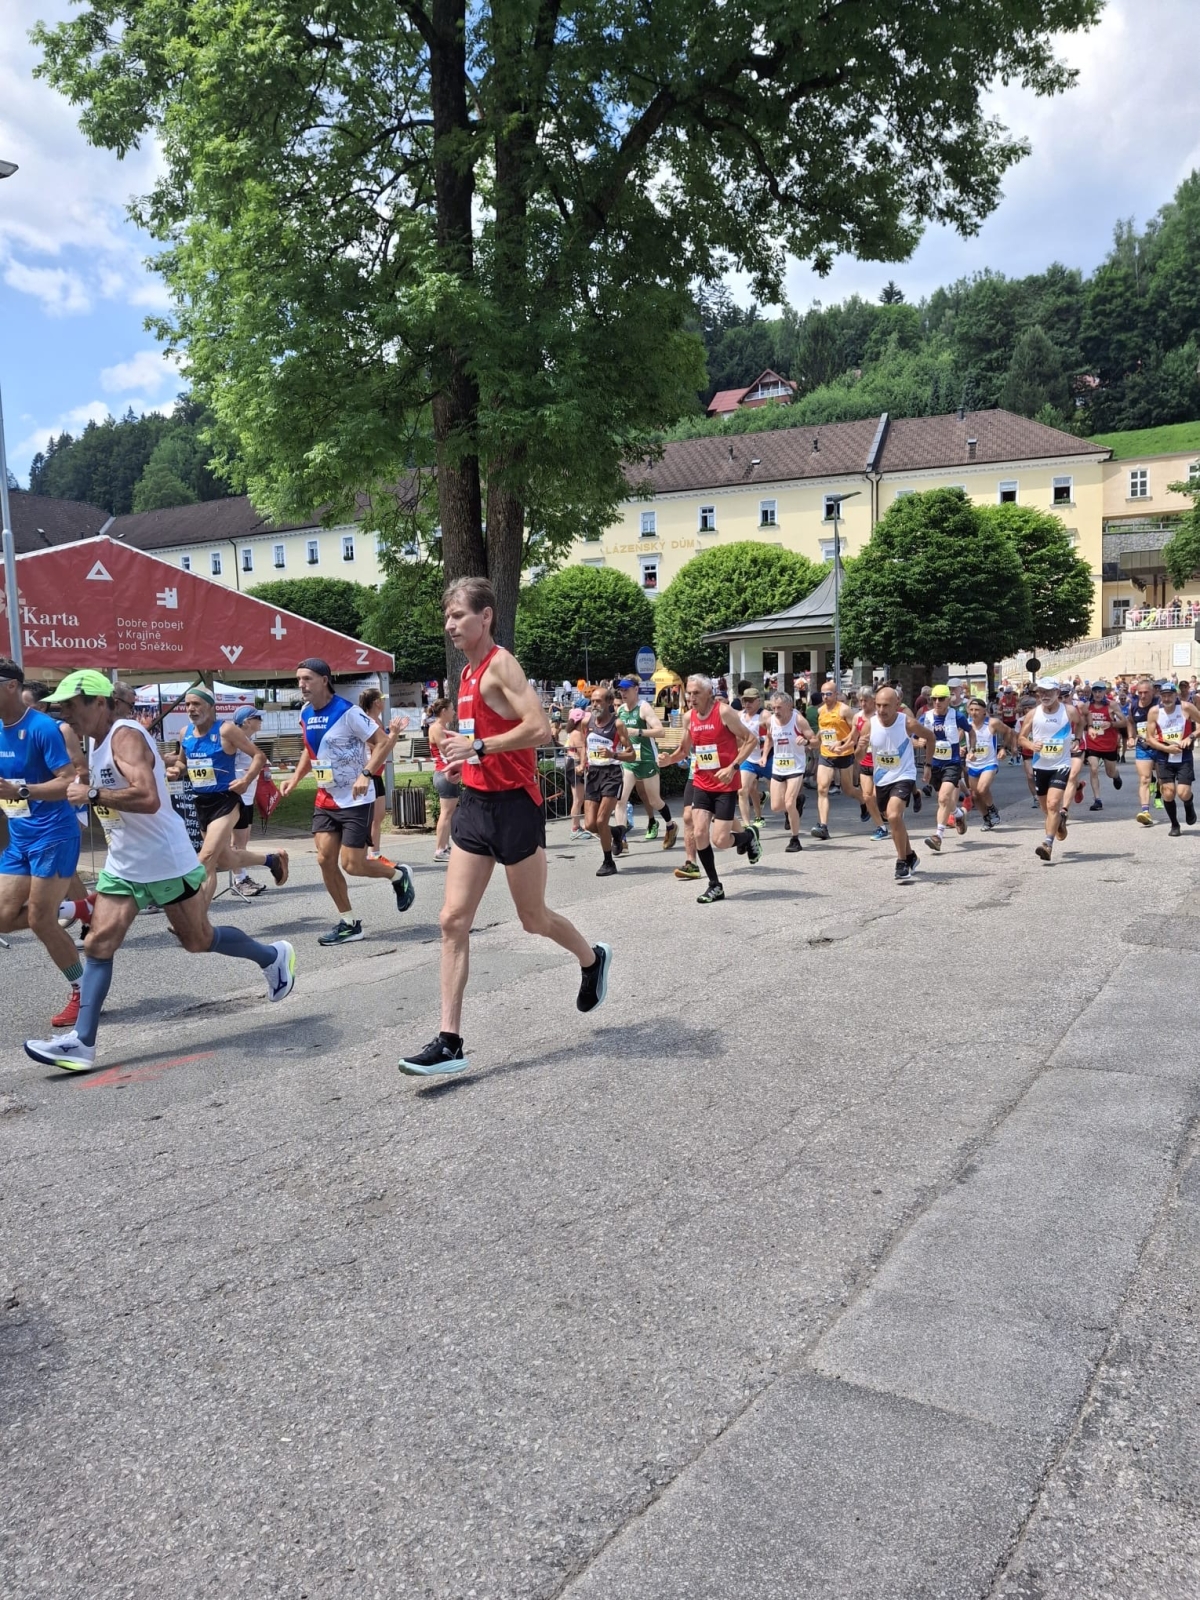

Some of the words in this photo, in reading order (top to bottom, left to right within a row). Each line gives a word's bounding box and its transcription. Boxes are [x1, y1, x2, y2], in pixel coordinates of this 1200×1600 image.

[606, 539, 666, 555] LÁZEŇSKÝ
[671, 537, 695, 550] DŮM
[22, 606, 80, 627] Karta
[117, 617, 148, 629] Dobře
[151, 619, 184, 632] pobejt
[23, 629, 107, 650] Krkonoš
[117, 631, 123, 639] v
[126, 629, 161, 642] Krajině
[118, 641, 137, 652] pod
[140, 640, 183, 653] Sněžkou
[307, 716, 329, 724] CZECH
[693, 723, 716, 732] AUSTRIA
[700, 753, 713, 762] 140
[193, 768, 208, 778] 149
